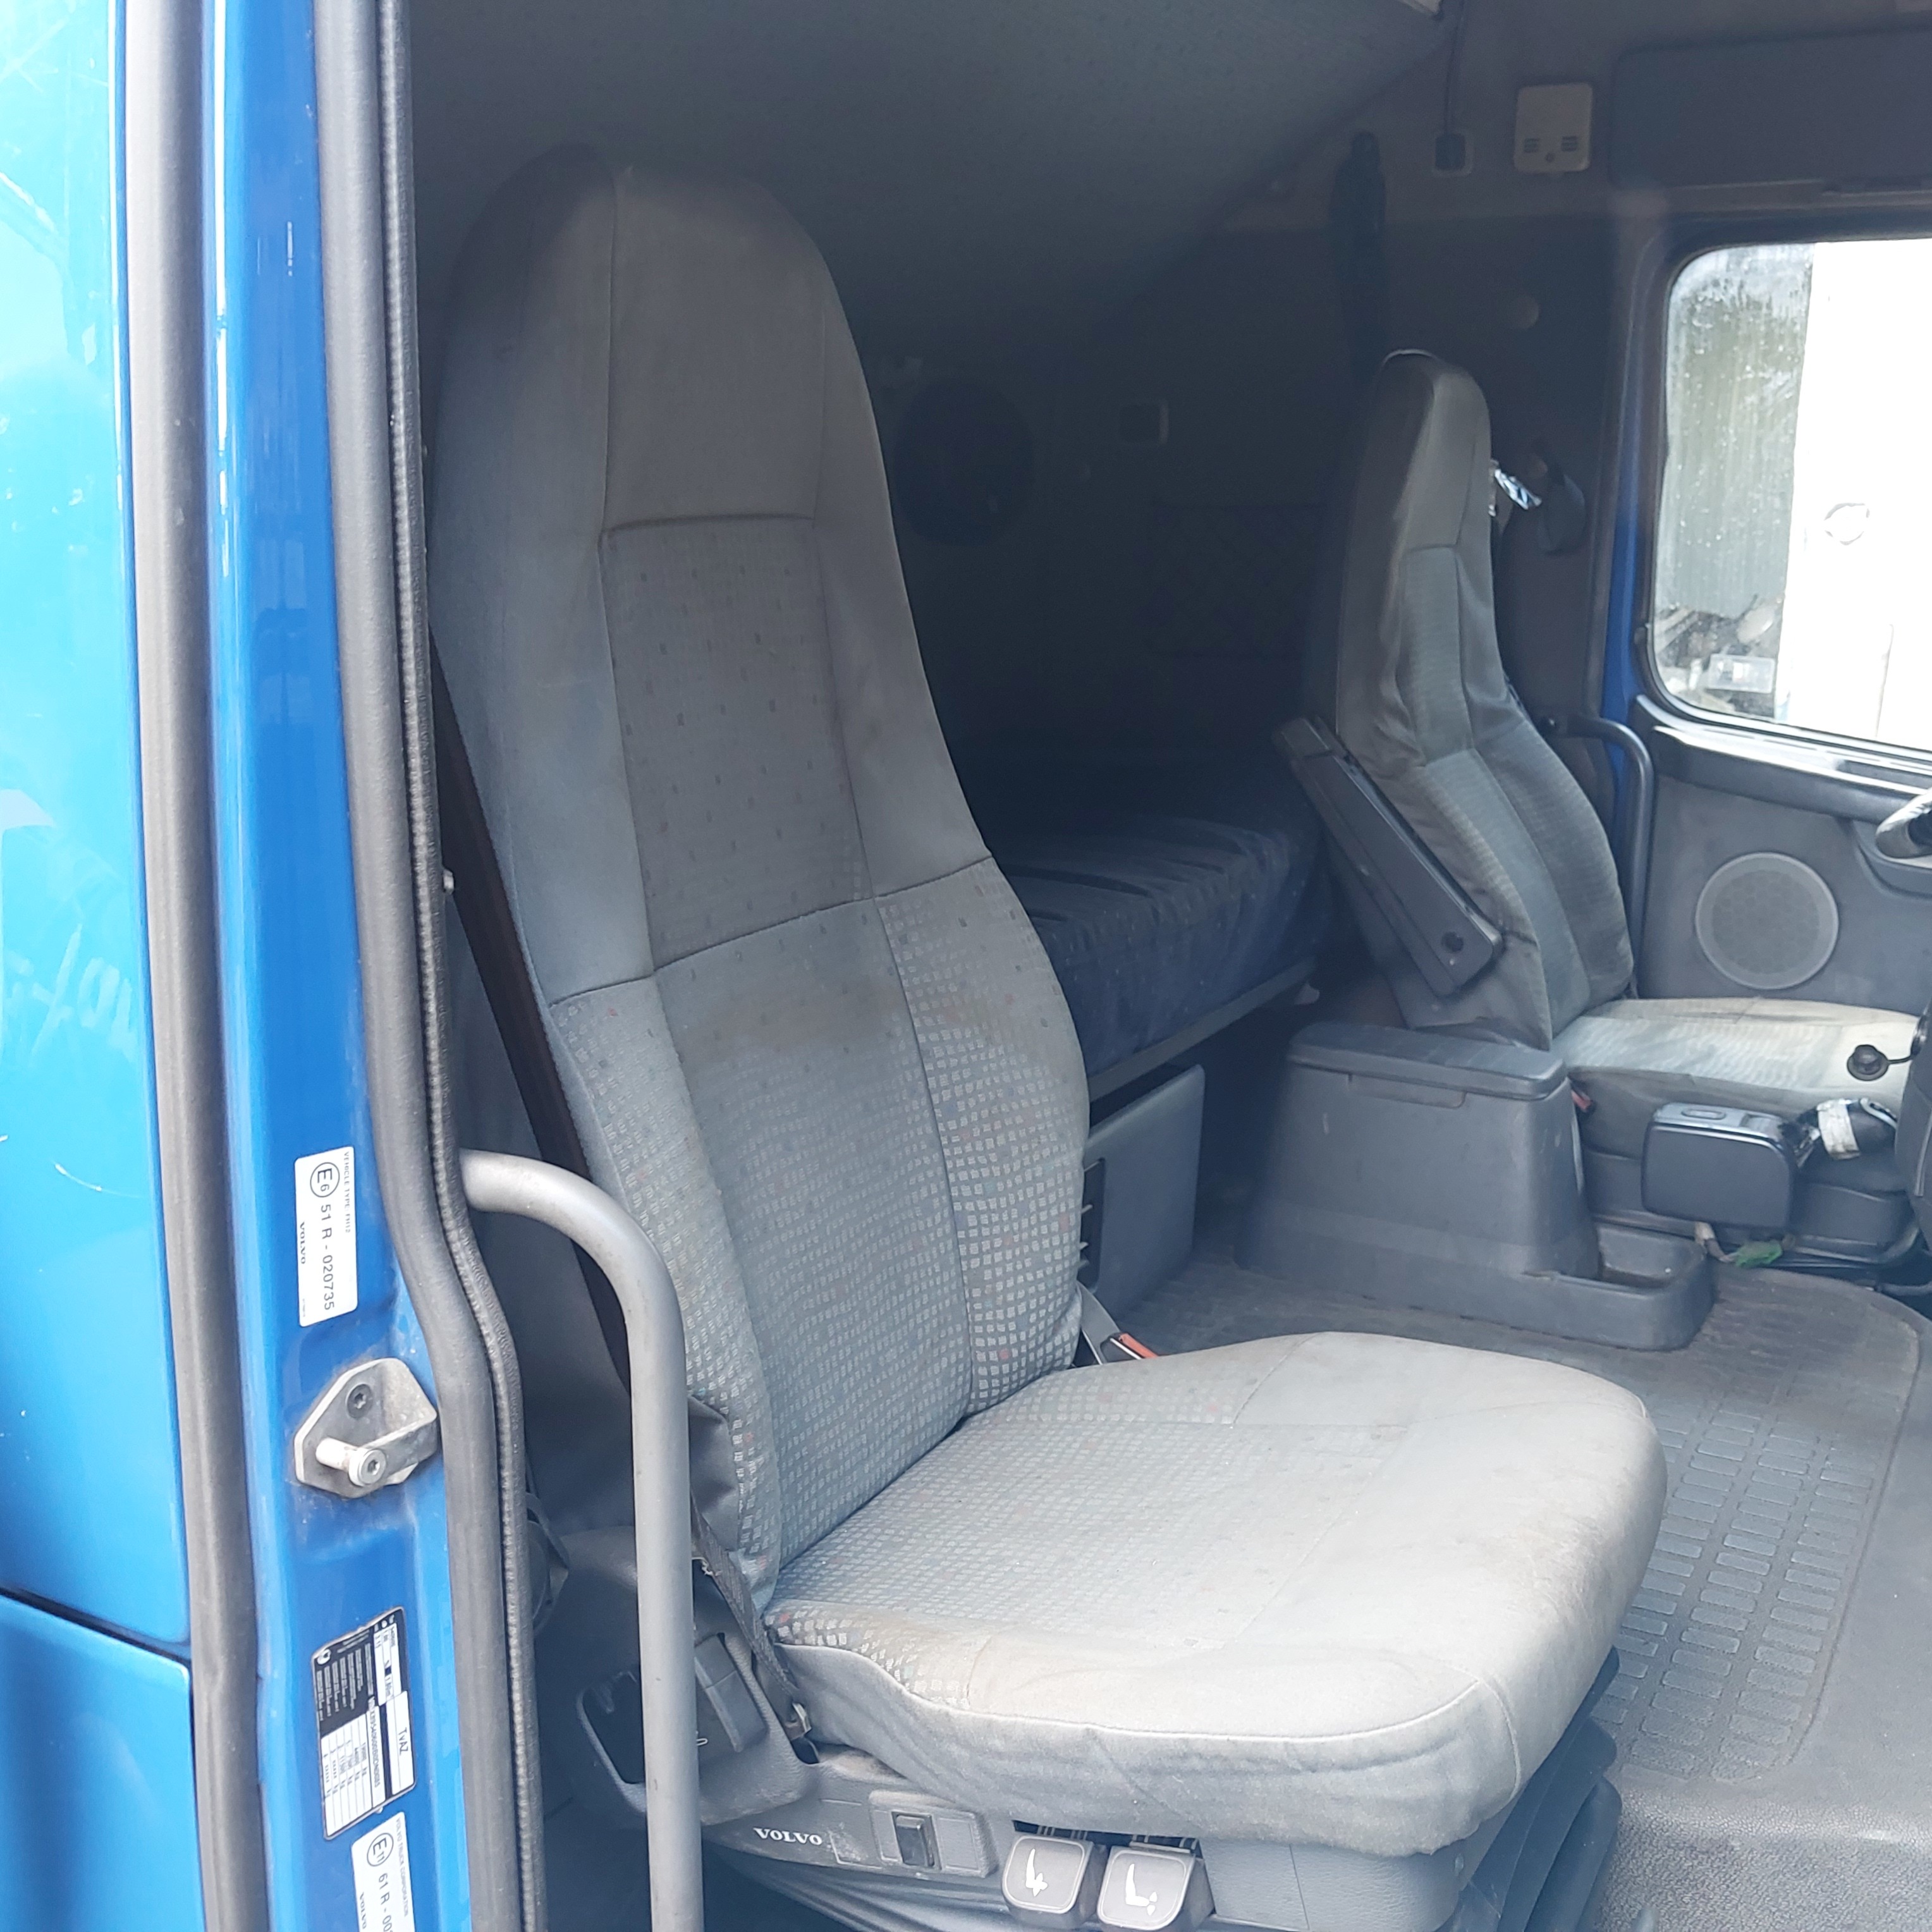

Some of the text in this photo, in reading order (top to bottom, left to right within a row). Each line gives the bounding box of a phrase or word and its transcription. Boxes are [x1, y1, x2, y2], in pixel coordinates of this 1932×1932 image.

[321, 1204, 331, 1221] 51
[322, 1228, 333, 1239] R
[322, 1255, 334, 1310] 020735
[398, 1727, 408, 1756] TvAZ
[752, 1827, 822, 1846] VOLVO
[379, 1873, 388, 1890] 61
[381, 1892, 389, 1905] R
[382, 1915, 393, 1932] 00
